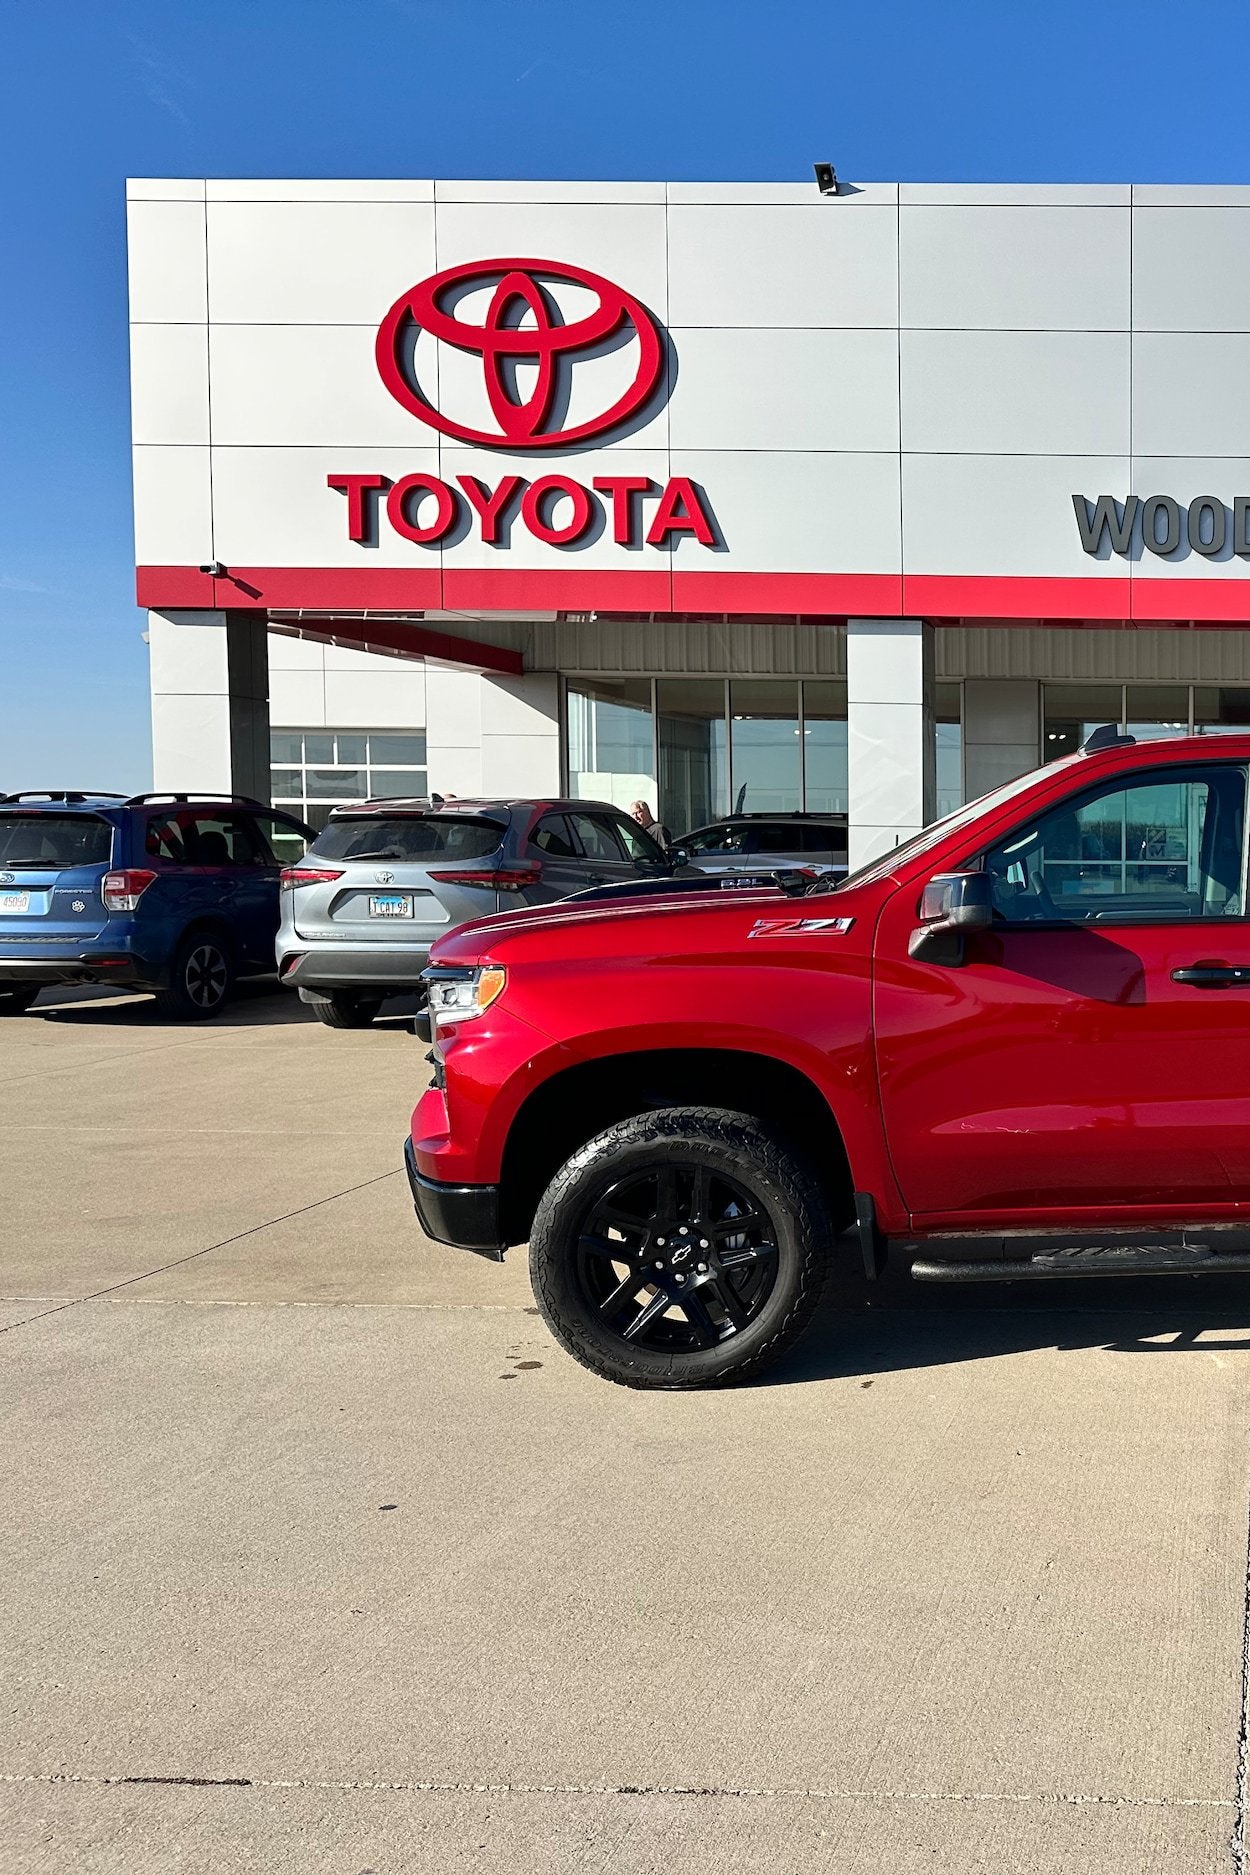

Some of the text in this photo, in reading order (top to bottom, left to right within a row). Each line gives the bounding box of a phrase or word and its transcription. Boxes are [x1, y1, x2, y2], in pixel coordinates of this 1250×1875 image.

[327, 472, 717, 545] TOYOTA
[380, 901, 396, 913] CAT
[397, 901, 408, 913] 98
[747, 917, 858, 939] Z71
